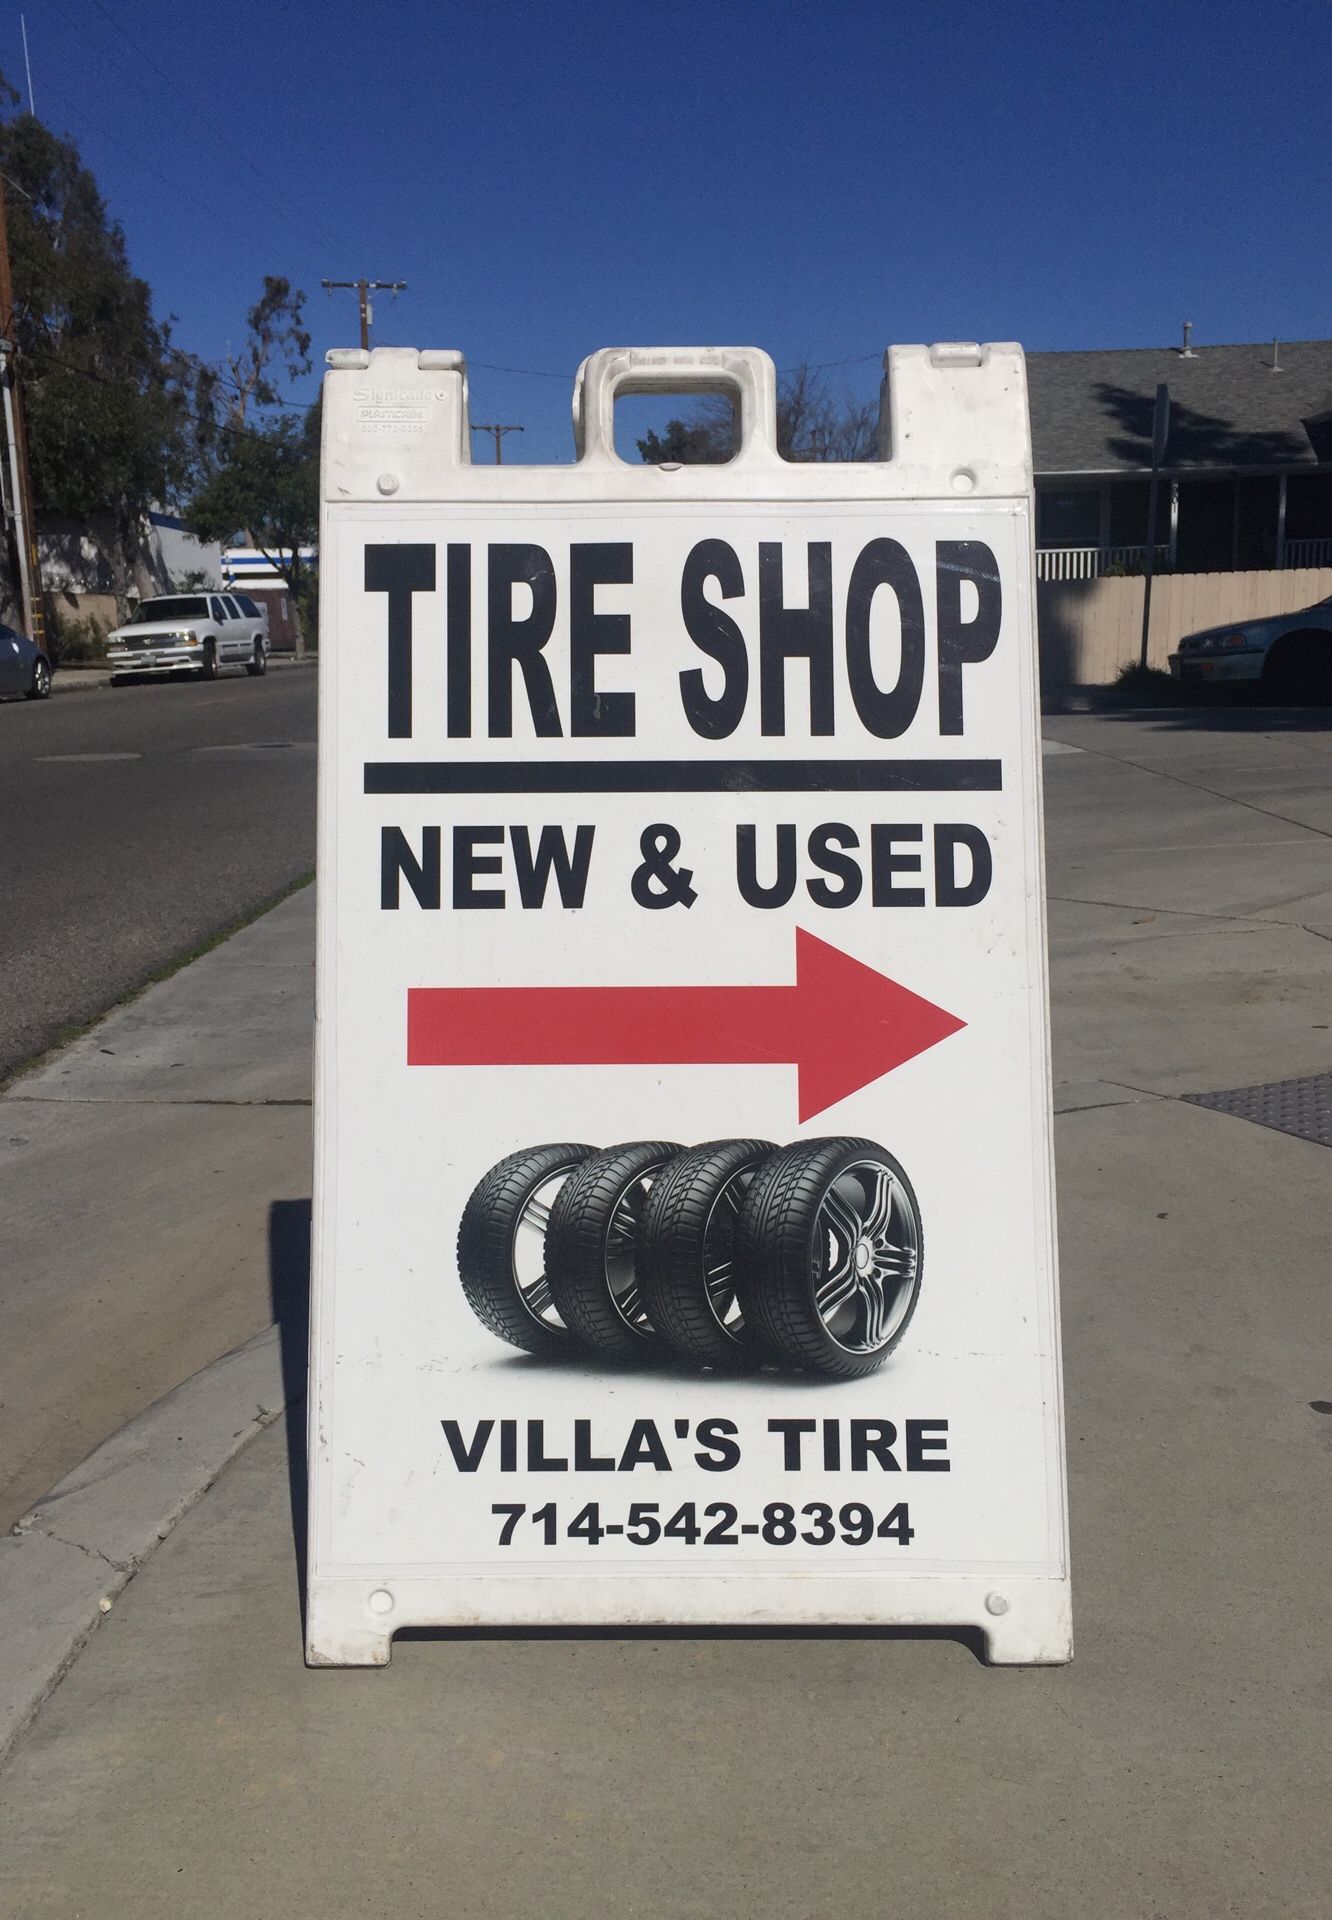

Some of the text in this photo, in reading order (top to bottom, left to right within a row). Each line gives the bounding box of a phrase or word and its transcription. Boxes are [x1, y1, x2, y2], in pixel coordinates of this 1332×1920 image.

[352, 386, 432, 404] Signicade
[365, 538, 1003, 741] TIRE SHOP
[381, 823, 993, 911] NEW & USED
[441, 1418, 951, 1473] VILLA'S TIRE
[492, 1503, 915, 1546] 714-542-8394
